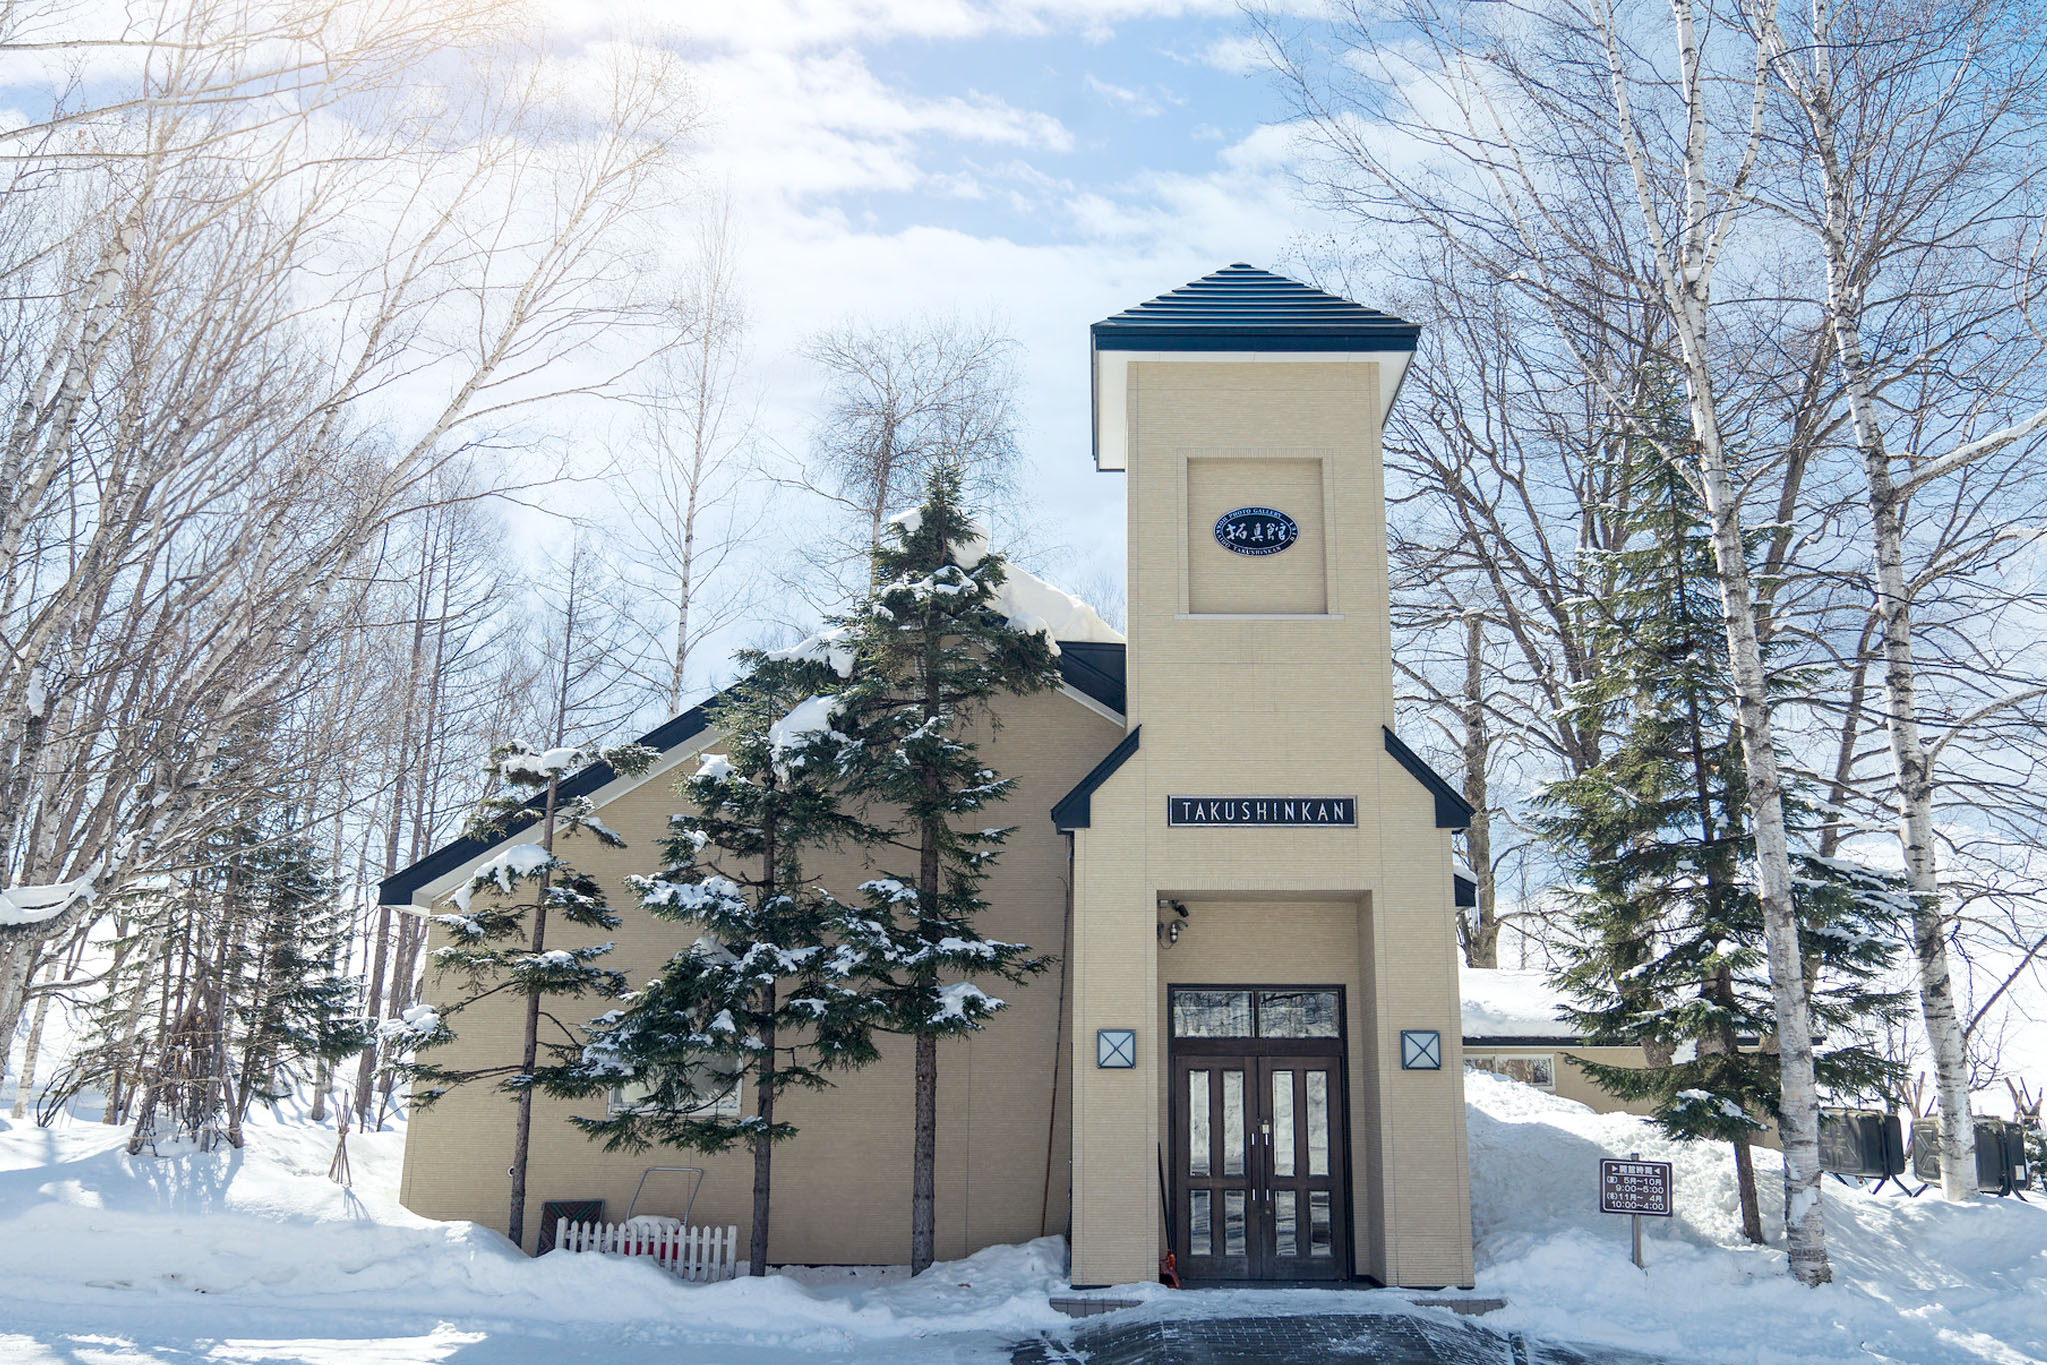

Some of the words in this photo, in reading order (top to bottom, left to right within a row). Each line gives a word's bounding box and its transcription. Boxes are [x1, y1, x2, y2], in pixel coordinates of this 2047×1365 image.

[1229, 509, 1251, 518] PHOTO
[1253, 507, 1282, 518] GALLERY
[1182, 801, 1344, 821] TAKUSHINKAN
